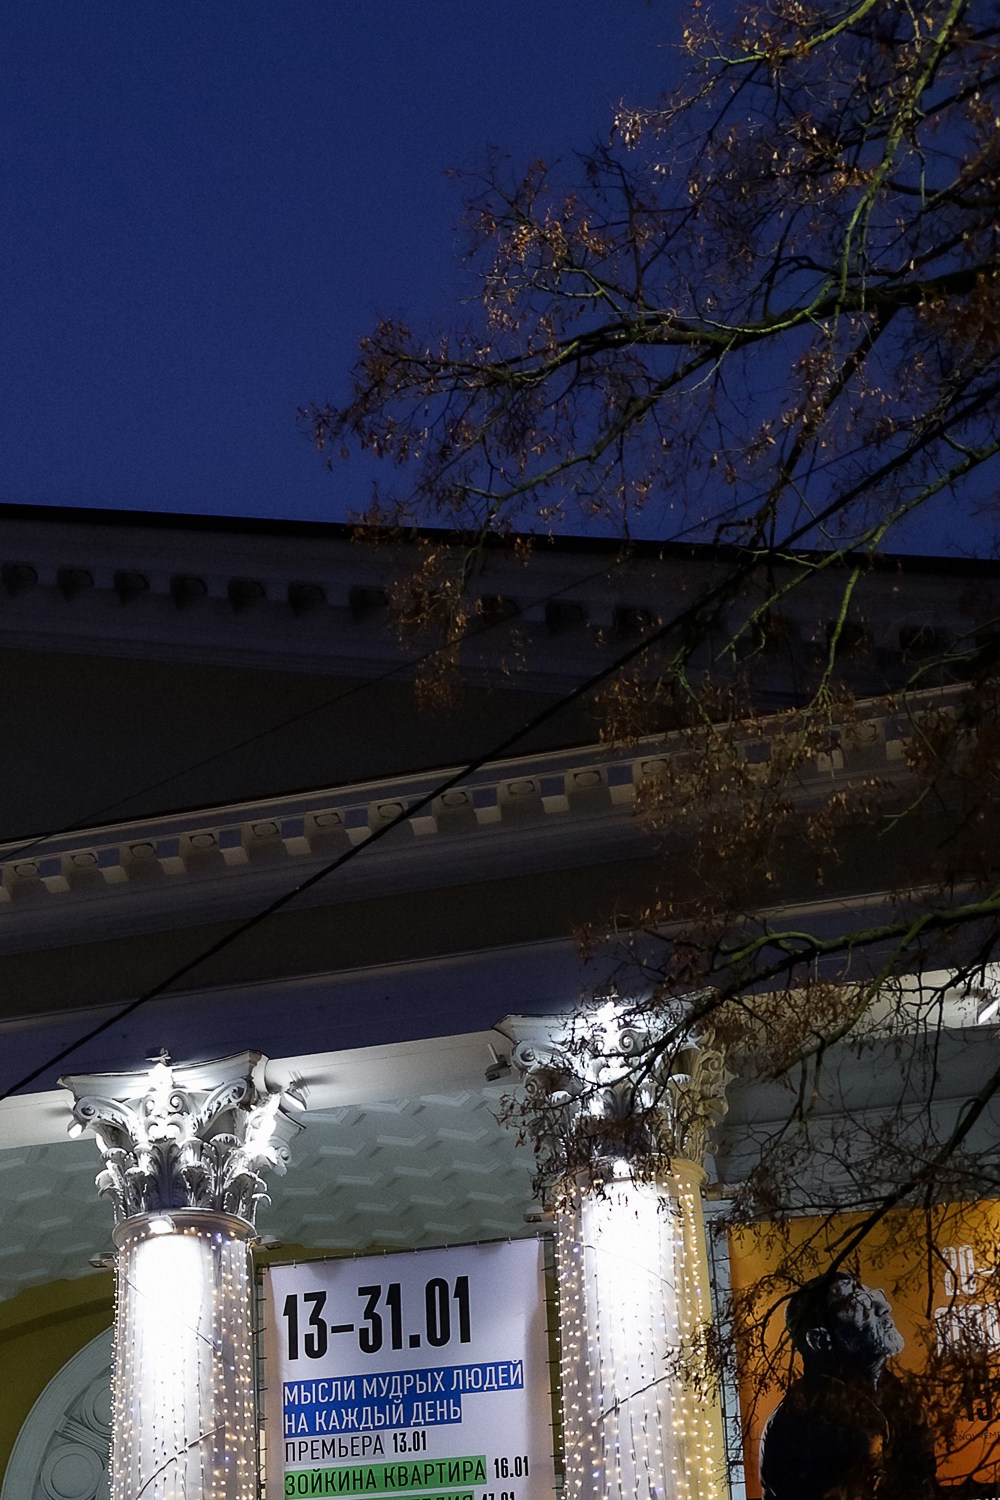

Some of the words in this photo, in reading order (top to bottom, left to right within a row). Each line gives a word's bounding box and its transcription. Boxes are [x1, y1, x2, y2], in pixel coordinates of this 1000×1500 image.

[283, 1275, 471, 1361] 13-31.01
[284, 1380, 356, 1406] МЫСЛИ
[363, 1371, 445, 1398] МУДРЫХ
[451, 1360, 522, 1390] ЛЮДЕЙ
[284, 1412, 309, 1434] НА
[315, 1399, 404, 1430] КАЖДЫЙ
[411, 1399, 461, 1425] ДЕНЬ
[285, 1434, 384, 1462] ПРЕМЬЕРА
[393, 1430, 427, 1453] 13.01
[285, 1468, 377, 1495] ЗОЙКИНА
[384, 1459, 486, 1488] КВАРТИРА
[494, 1456, 529, 1479] 16.01
